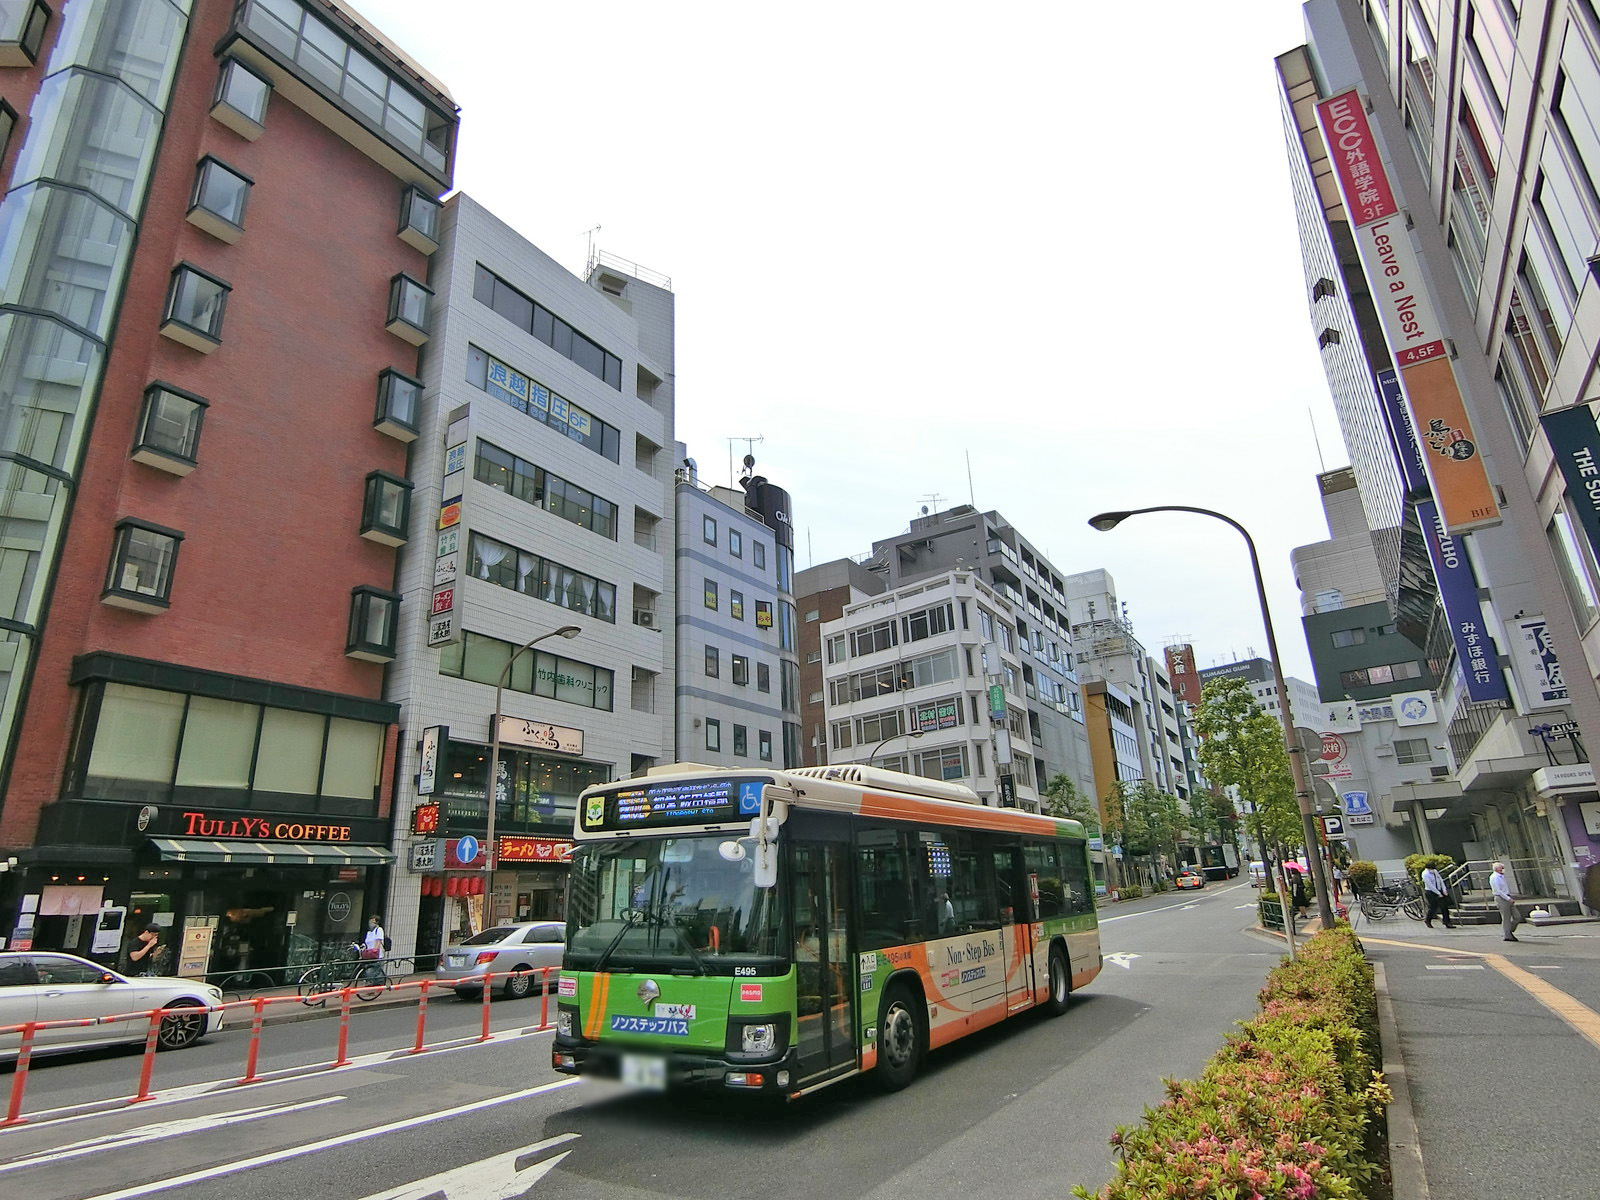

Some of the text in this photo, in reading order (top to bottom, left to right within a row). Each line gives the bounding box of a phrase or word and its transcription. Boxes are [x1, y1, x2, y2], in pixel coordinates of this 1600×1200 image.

[1363, 203, 1384, 220] 3F
[1371, 221, 1425, 341] Leave a Nest
[489, 360, 588, 429] 浪越指圧 6F
[1572, 446, 1600, 478] THE
[1461, 621, 1491, 684] みずほ銀行
[537, 667, 608, 694] 竹内歯科クリニック
[1202, 664, 1251, 679] KUMAGAI GUMI
[274, 823, 351, 841] COFFEE
[1324, 818, 1341, 834] P
[503, 841, 536, 857] ラーメン
[982, 939, 996, 958] Bus
[734, 966, 757, 976] E495
[611, 1016, 689, 1035] ノンステップバス
